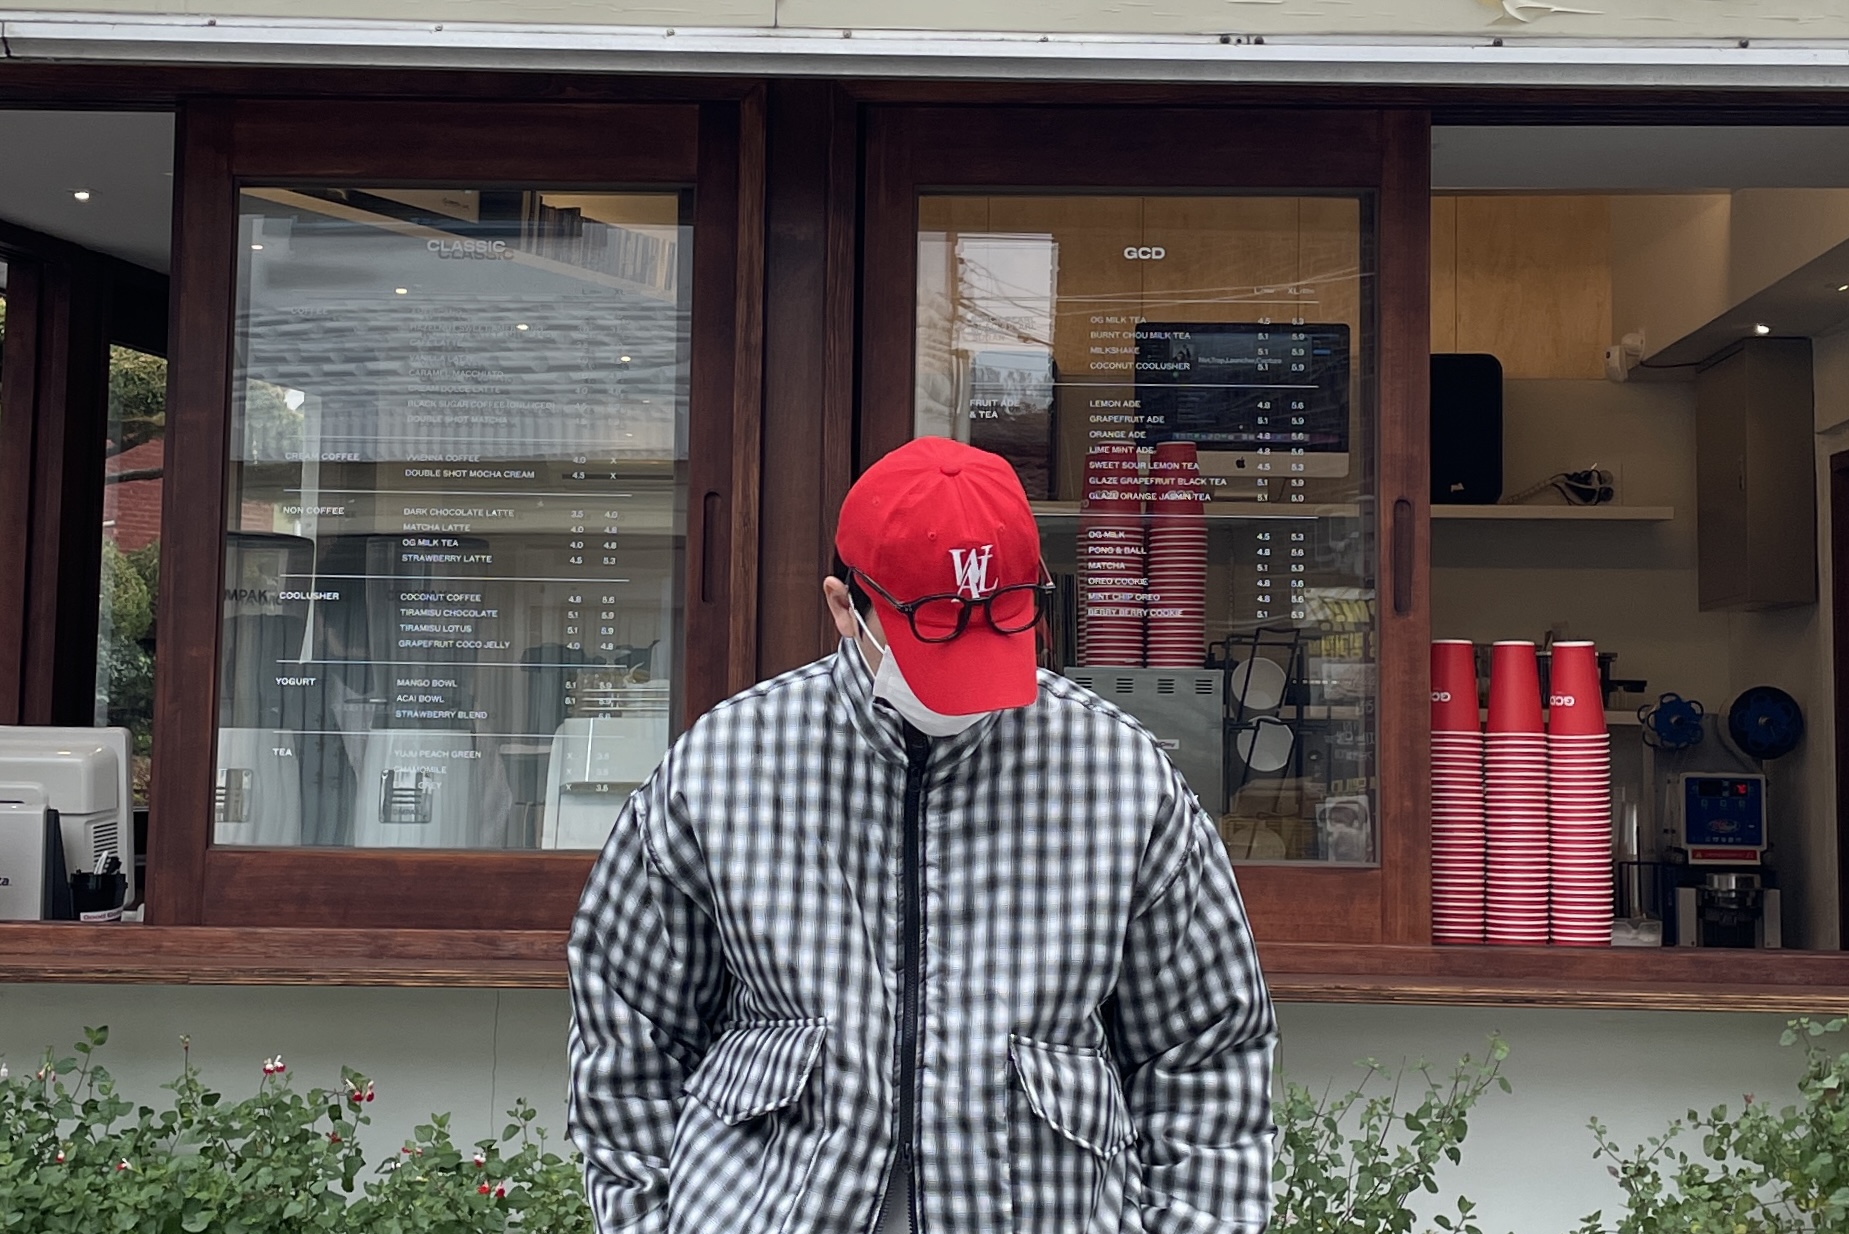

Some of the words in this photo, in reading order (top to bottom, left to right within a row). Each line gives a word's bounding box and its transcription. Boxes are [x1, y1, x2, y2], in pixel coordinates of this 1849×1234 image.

[427, 241, 506, 252] CLASSIC
[1123, 247, 1166, 260] GCD
[1090, 316, 1104, 324] OG
[1105, 316, 1127, 324] MILK
[1129, 316, 1147, 324] TEA
[1090, 331, 1121, 339] BURNT
[1149, 332, 1172, 340] MILK
[1173, 332, 1192, 340] TEA
[1090, 346, 1141, 355] MILKSHAKE
[1257, 348, 1269, 356] 5.1
[1090, 362, 1134, 370] COCONUT
[1136, 362, 1191, 370] COOLUSHER
[970, 399, 998, 407] FRUIT
[1001, 400, 1020, 408] ADE
[1089, 400, 1122, 408] LEMON
[1122, 400, 1142, 408] ADE
[1089, 415, 1145, 424] GRAPEFRUIT
[1146, 415, 1165, 424] ADE
[1089, 430, 1126, 439] ORANGE
[1128, 431, 1147, 439] ADE
[1089, 446, 1110, 454] LIME
[1111, 446, 1135, 454] MINT
[1136, 447, 1155, 455] ADE
[321, 453, 361, 461] COFFEE
[445, 454, 480, 462] COFFEE
[610, 457, 617, 465] X
[1089, 461, 1120, 469] SWEET
[1121, 461, 1147, 470] SOUR
[1148, 462, 1180, 470] LEMON
[1182, 462, 1201, 470] TEA
[405, 469, 442, 478] DOUBLE
[443, 469, 468, 478] SHOT
[469, 470, 501, 478] MOCHA
[503, 470, 535, 479] CREAM
[572, 472, 585, 480] 4.5
[1089, 476, 1119, 485] GLAZE
[1120, 477, 1176, 486] GRAPEFRUIT
[1178, 477, 1208, 486] BLACK
[1209, 478, 1228, 486] TEA
[1120, 492, 1158, 501] ORANGE
[1193, 493, 1212, 501] TEA
[283, 506, 304, 514] NON
[306, 507, 345, 515] COFFEE
[403, 508, 428, 516] DARK
[429, 508, 484, 517] CHOCOLATE
[486, 509, 515, 518] LATTE
[403, 523, 440, 531] MATCHA
[442, 524, 471, 532] LATTE
[1088, 530, 1102, 539] OG
[402, 538, 417, 547] OG
[417, 539, 439, 547] MILK
[441, 539, 459, 547] TEA
[569, 541, 584, 550] 4.0
[1116, 546, 1122, 554] &
[1124, 547, 1148, 555] BALL
[401, 554, 462, 563] STRAWBERRY
[463, 555, 493, 564] LATTE
[1088, 562, 1126, 570] MATCHA
[1088, 577, 1114, 585] OREO
[1114, 578, 1149, 586] COOKIE
[224, 589, 268, 601] MPAK
[279, 591, 340, 600] COOLUSHER
[400, 593, 445, 602] COCONUT
[446, 594, 482, 603] COFFEE
[1088, 592, 1112, 600] MINT
[1113, 593, 1134, 601] CHIP
[1135, 593, 1161, 601] OREO
[400, 608, 442, 618] TIRAMISU
[443, 609, 499, 618] CHOCOLATE
[567, 611, 579, 620] 5.1
[1088, 608, 1118, 616] BERRY
[1119, 608, 1149, 617] BERRY
[1149, 608, 1183, 617] COOKIE
[399, 623, 442, 633] TIRAMISU
[442, 624, 473, 634] LOTUS
[398, 640, 455, 648] GRAPEFRUIT
[455, 640, 483, 649] COCO
[483, 640, 511, 649] JELLY
[566, 642, 581, 650] 4.0
[275, 677, 317, 686] YOGURT
[396, 679, 431, 688] MANGO
[431, 679, 458, 688] BOWL
[396, 695, 417, 703] ACAI
[418, 695, 446, 704] BOWL
[395, 709, 458, 718] STRAWBERRY
[457, 710, 488, 720] BLEND
[272, 748, 293, 757] TEA
[394, 750, 418, 758] YUJU
[419, 750, 450, 758] PEACH
[451, 751, 482, 759] GREEN
